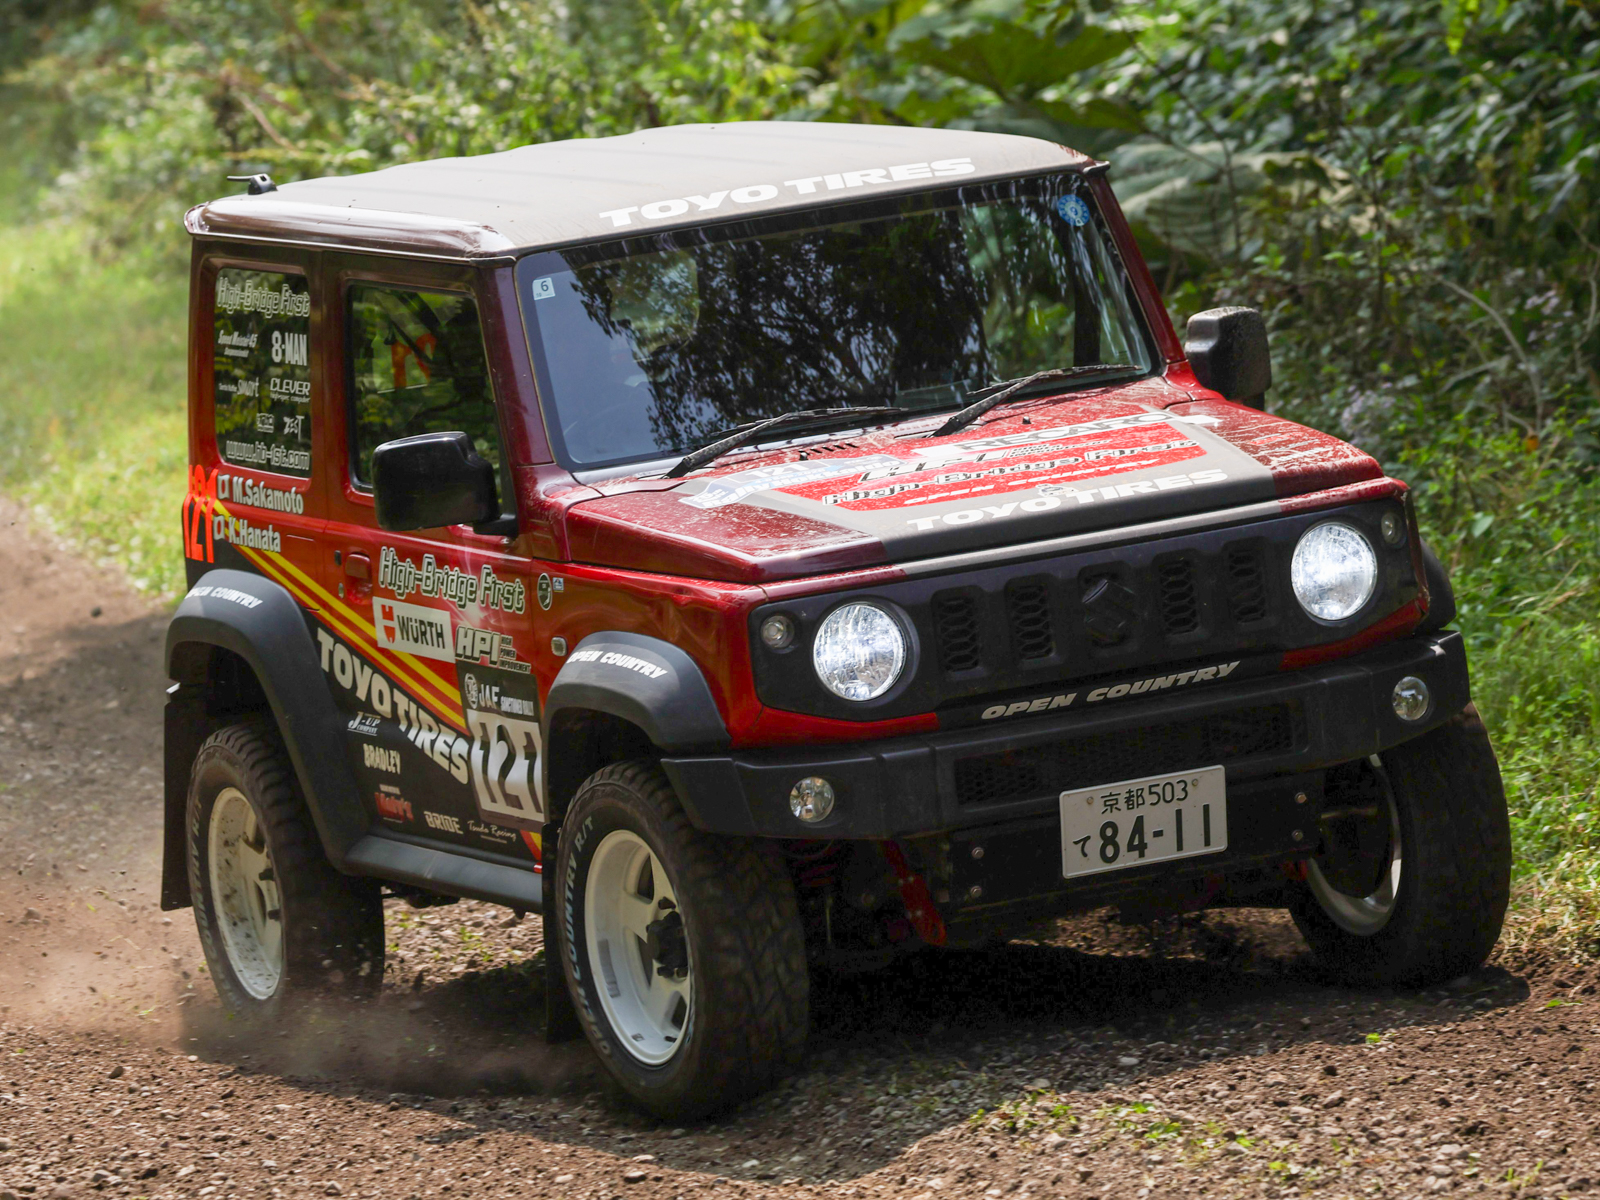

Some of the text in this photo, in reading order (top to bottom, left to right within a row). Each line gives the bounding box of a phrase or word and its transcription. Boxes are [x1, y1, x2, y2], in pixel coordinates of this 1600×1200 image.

[599, 158, 976, 227] TOYO TIRES
[217, 277, 310, 318] High-Bridge First
[540, 280, 549, 292] 6
[270, 377, 311, 396] CLEVER
[954, 413, 1174, 451] RECARO
[744, 463, 809, 480] 121
[822, 440, 1200, 506] High-Bridge First
[904, 458, 1160, 505] OPEN COUNTRY
[232, 475, 304, 515] M.Sakamoto
[906, 468, 1228, 531] TOYO TIRES
[229, 515, 281, 553] K.Hanata
[210, 586, 264, 609] COUNTRY
[379, 546, 478, 610] High-Bridge
[479, 564, 525, 614] First
[455, 625, 500, 667] HPI
[600, 652, 668, 679] COUNTRY
[317, 627, 469, 785] TOYO TIRES
[479, 684, 500, 710] JAF
[981, 661, 1241, 720] OPEN COUNTRY
[348, 711, 381, 730] J-UP
[363, 743, 401, 775] BRADLEY
[479, 722, 544, 814] 121
[423, 810, 464, 835] BRIDE
[1099, 803, 1212, 864] 84-11
[564, 850, 581, 980] COUNTRY
[574, 815, 594, 853] R/T
